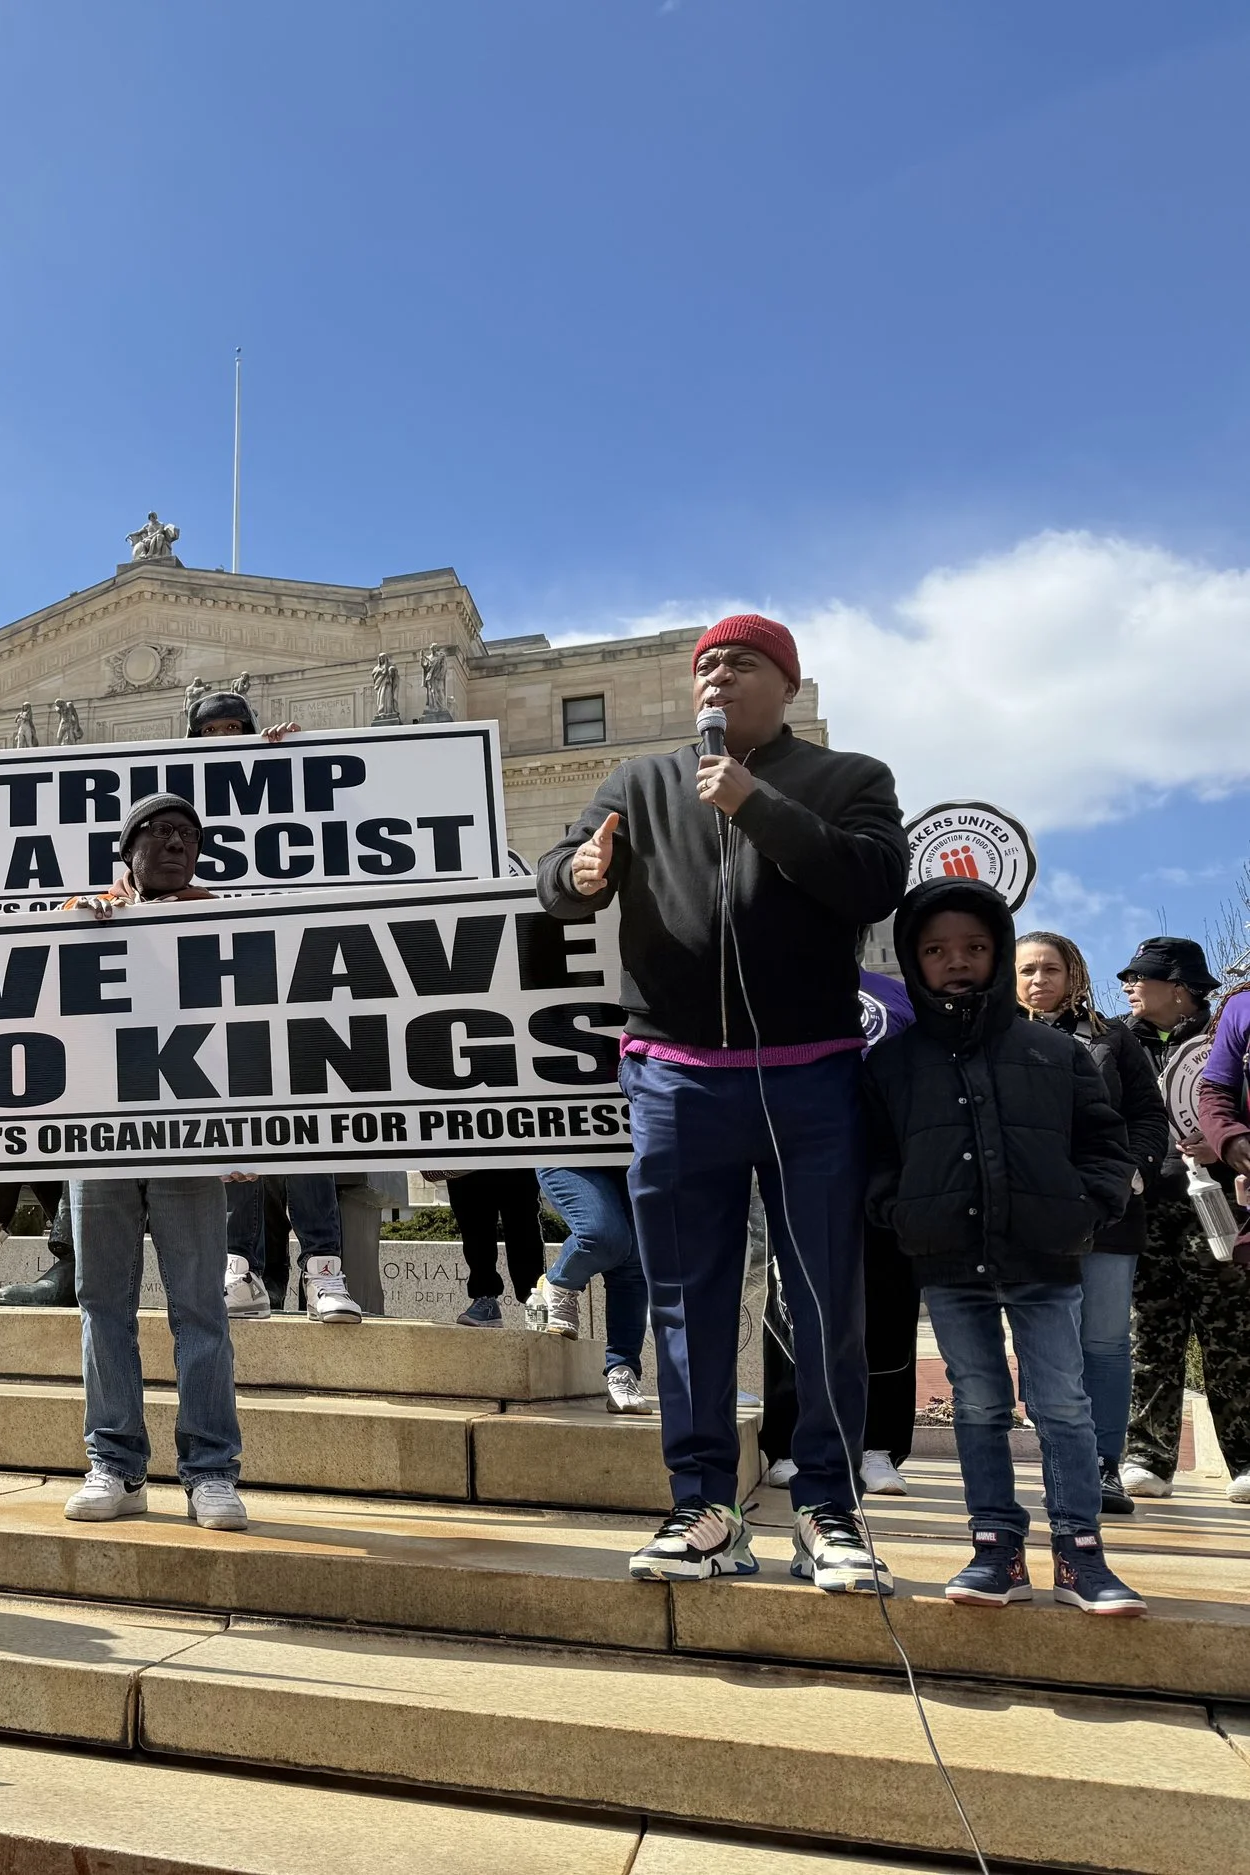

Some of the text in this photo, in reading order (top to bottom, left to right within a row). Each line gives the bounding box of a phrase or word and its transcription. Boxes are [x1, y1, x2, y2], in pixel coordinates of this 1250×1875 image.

[958, 816, 1010, 844] UNITED
[4, 835, 65, 890] A
[88, 815, 475, 886] FSCIST
[926, 834, 963, 862] DISTRIBUTION
[972, 836, 989, 850] FOOD
[986, 849, 997, 875] SERVICE
[178, 912, 605, 1010] HAVE
[116, 1002, 628, 1102] KINGS
[38, 1115, 322, 1153] ORGANIZATION
[330, 1111, 407, 1145] FOR
[975, 1532, 997, 1541] MARVEL
[1075, 1536, 1098, 1546] MARVEL
